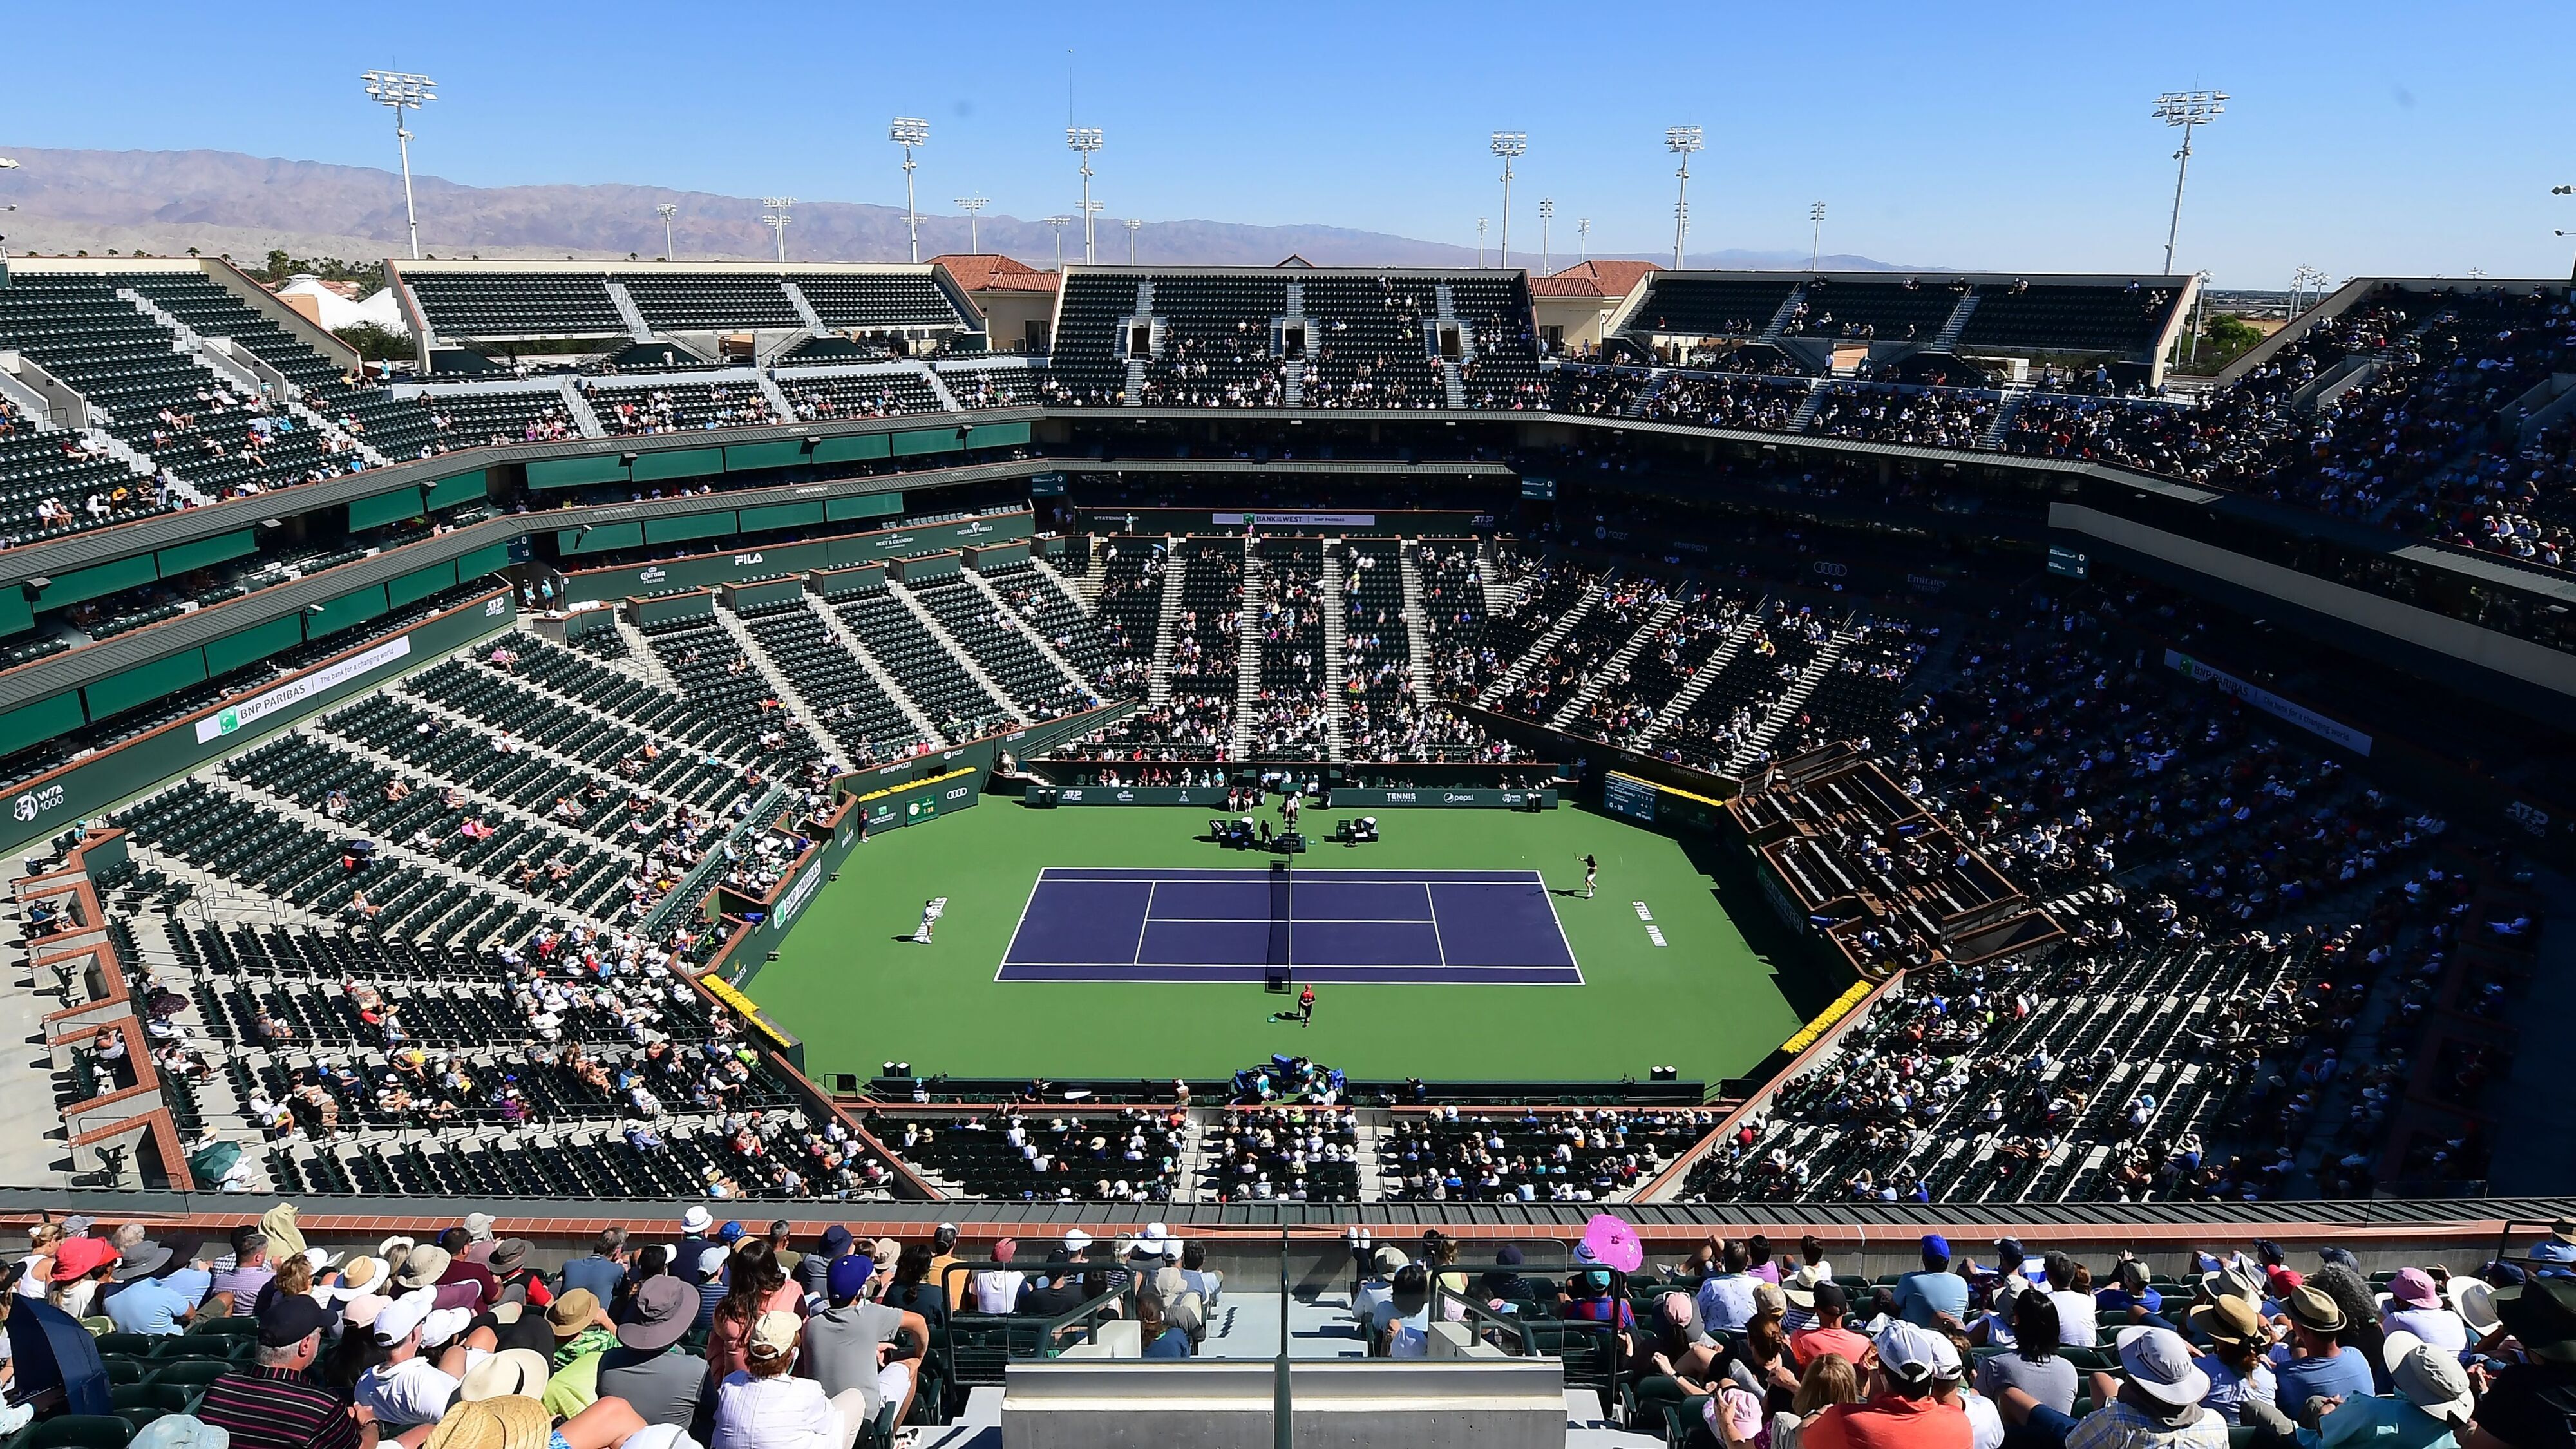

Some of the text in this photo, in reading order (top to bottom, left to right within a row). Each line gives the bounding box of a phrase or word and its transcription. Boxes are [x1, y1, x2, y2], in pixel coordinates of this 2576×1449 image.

[893, 536, 914, 545] CHANDON
[735, 553, 764, 566] FILA
[640, 570, 666, 581] Corona
[2076, 566, 2084, 574] 15
[643, 577, 665, 585] PREMIER
[1908, 573, 1947, 588] Emirates
[331, 669, 345, 679] bank
[345, 665, 354, 676] for
[357, 654, 381, 668] changing
[380, 647, 395, 658] world
[2194, 665, 2211, 679] BNP
[240, 684, 305, 719] BNP PARIBAS
[1620, 753, 1638, 763] FILA
[880, 761, 913, 775] #BNPPO21
[37, 784, 64, 800] WTA
[39, 795, 64, 811] 1000
[2506, 801, 2549, 825] ATP
[841, 829, 854, 848] ROLEX
[786, 891, 797, 912] BNP
[799, 862, 819, 896] PARIBAS
